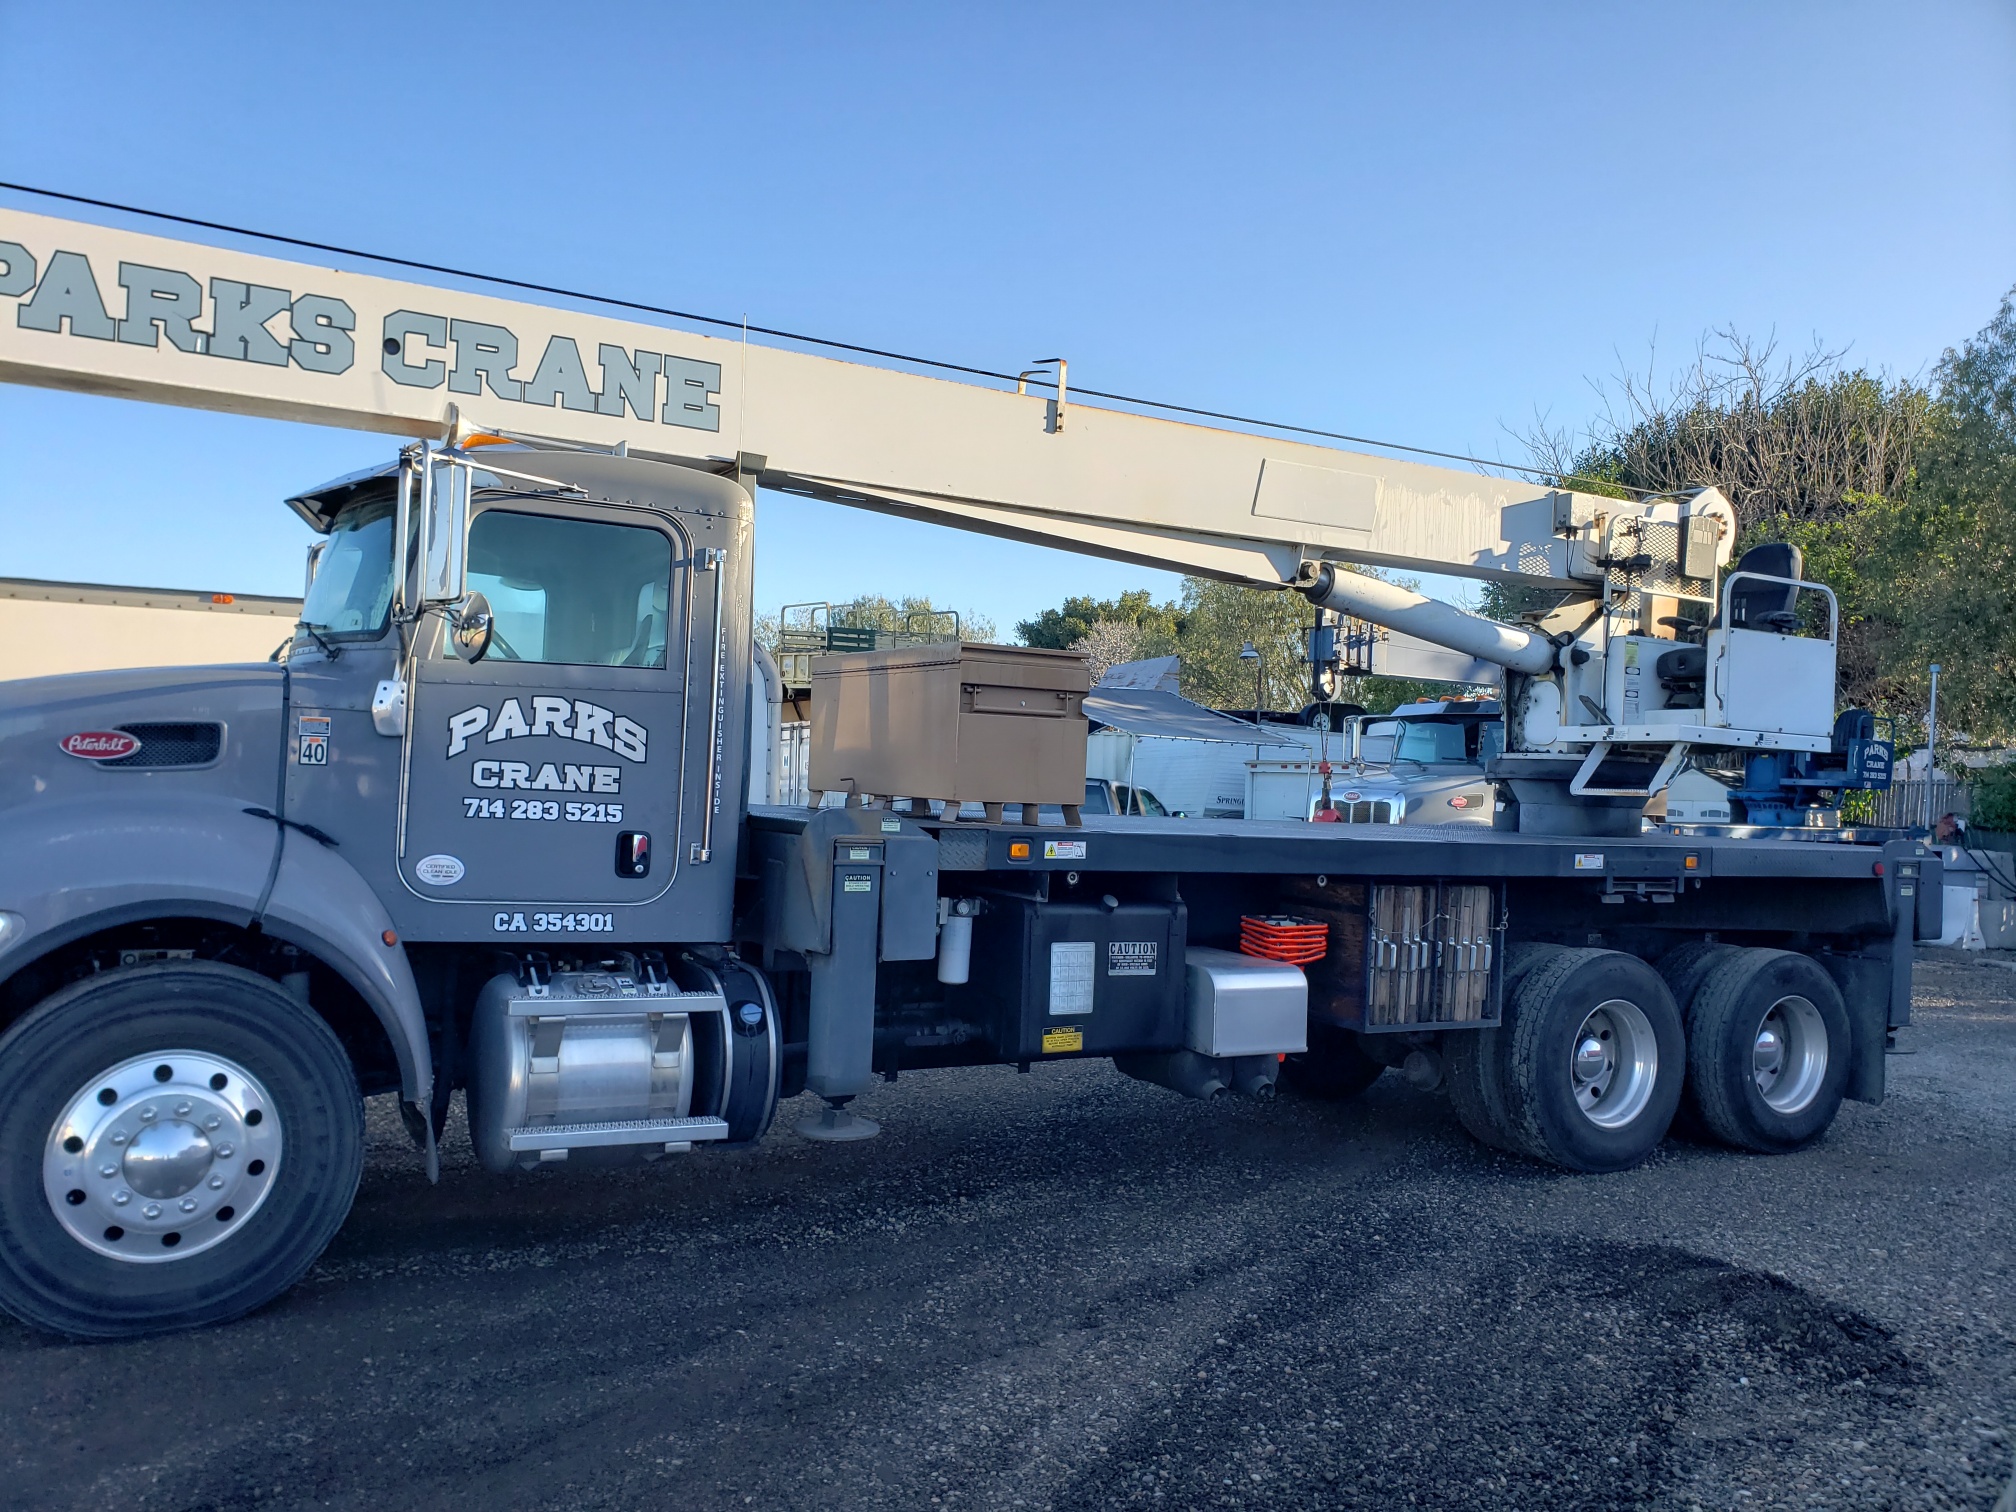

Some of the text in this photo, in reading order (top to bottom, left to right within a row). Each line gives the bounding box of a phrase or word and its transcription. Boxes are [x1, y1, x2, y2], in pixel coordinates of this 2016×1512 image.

[381, 309, 722, 433] CRANE
[716, 664, 726, 762] EXTINGUISHER
[446, 695, 648, 763] PARKS
[68, 735, 130, 751] Peterbilt
[302, 743, 325, 763] 40
[1864, 744, 1888, 761] PARKS
[471, 759, 622, 794] CRANE
[1866, 761, 1885, 769] CRANE
[714, 765, 723, 814] INSIDE
[463, 797, 624, 824] 714 283 5215
[493, 912, 614, 932] CA 354301
[1110, 943, 1156, 954] CAUTION
